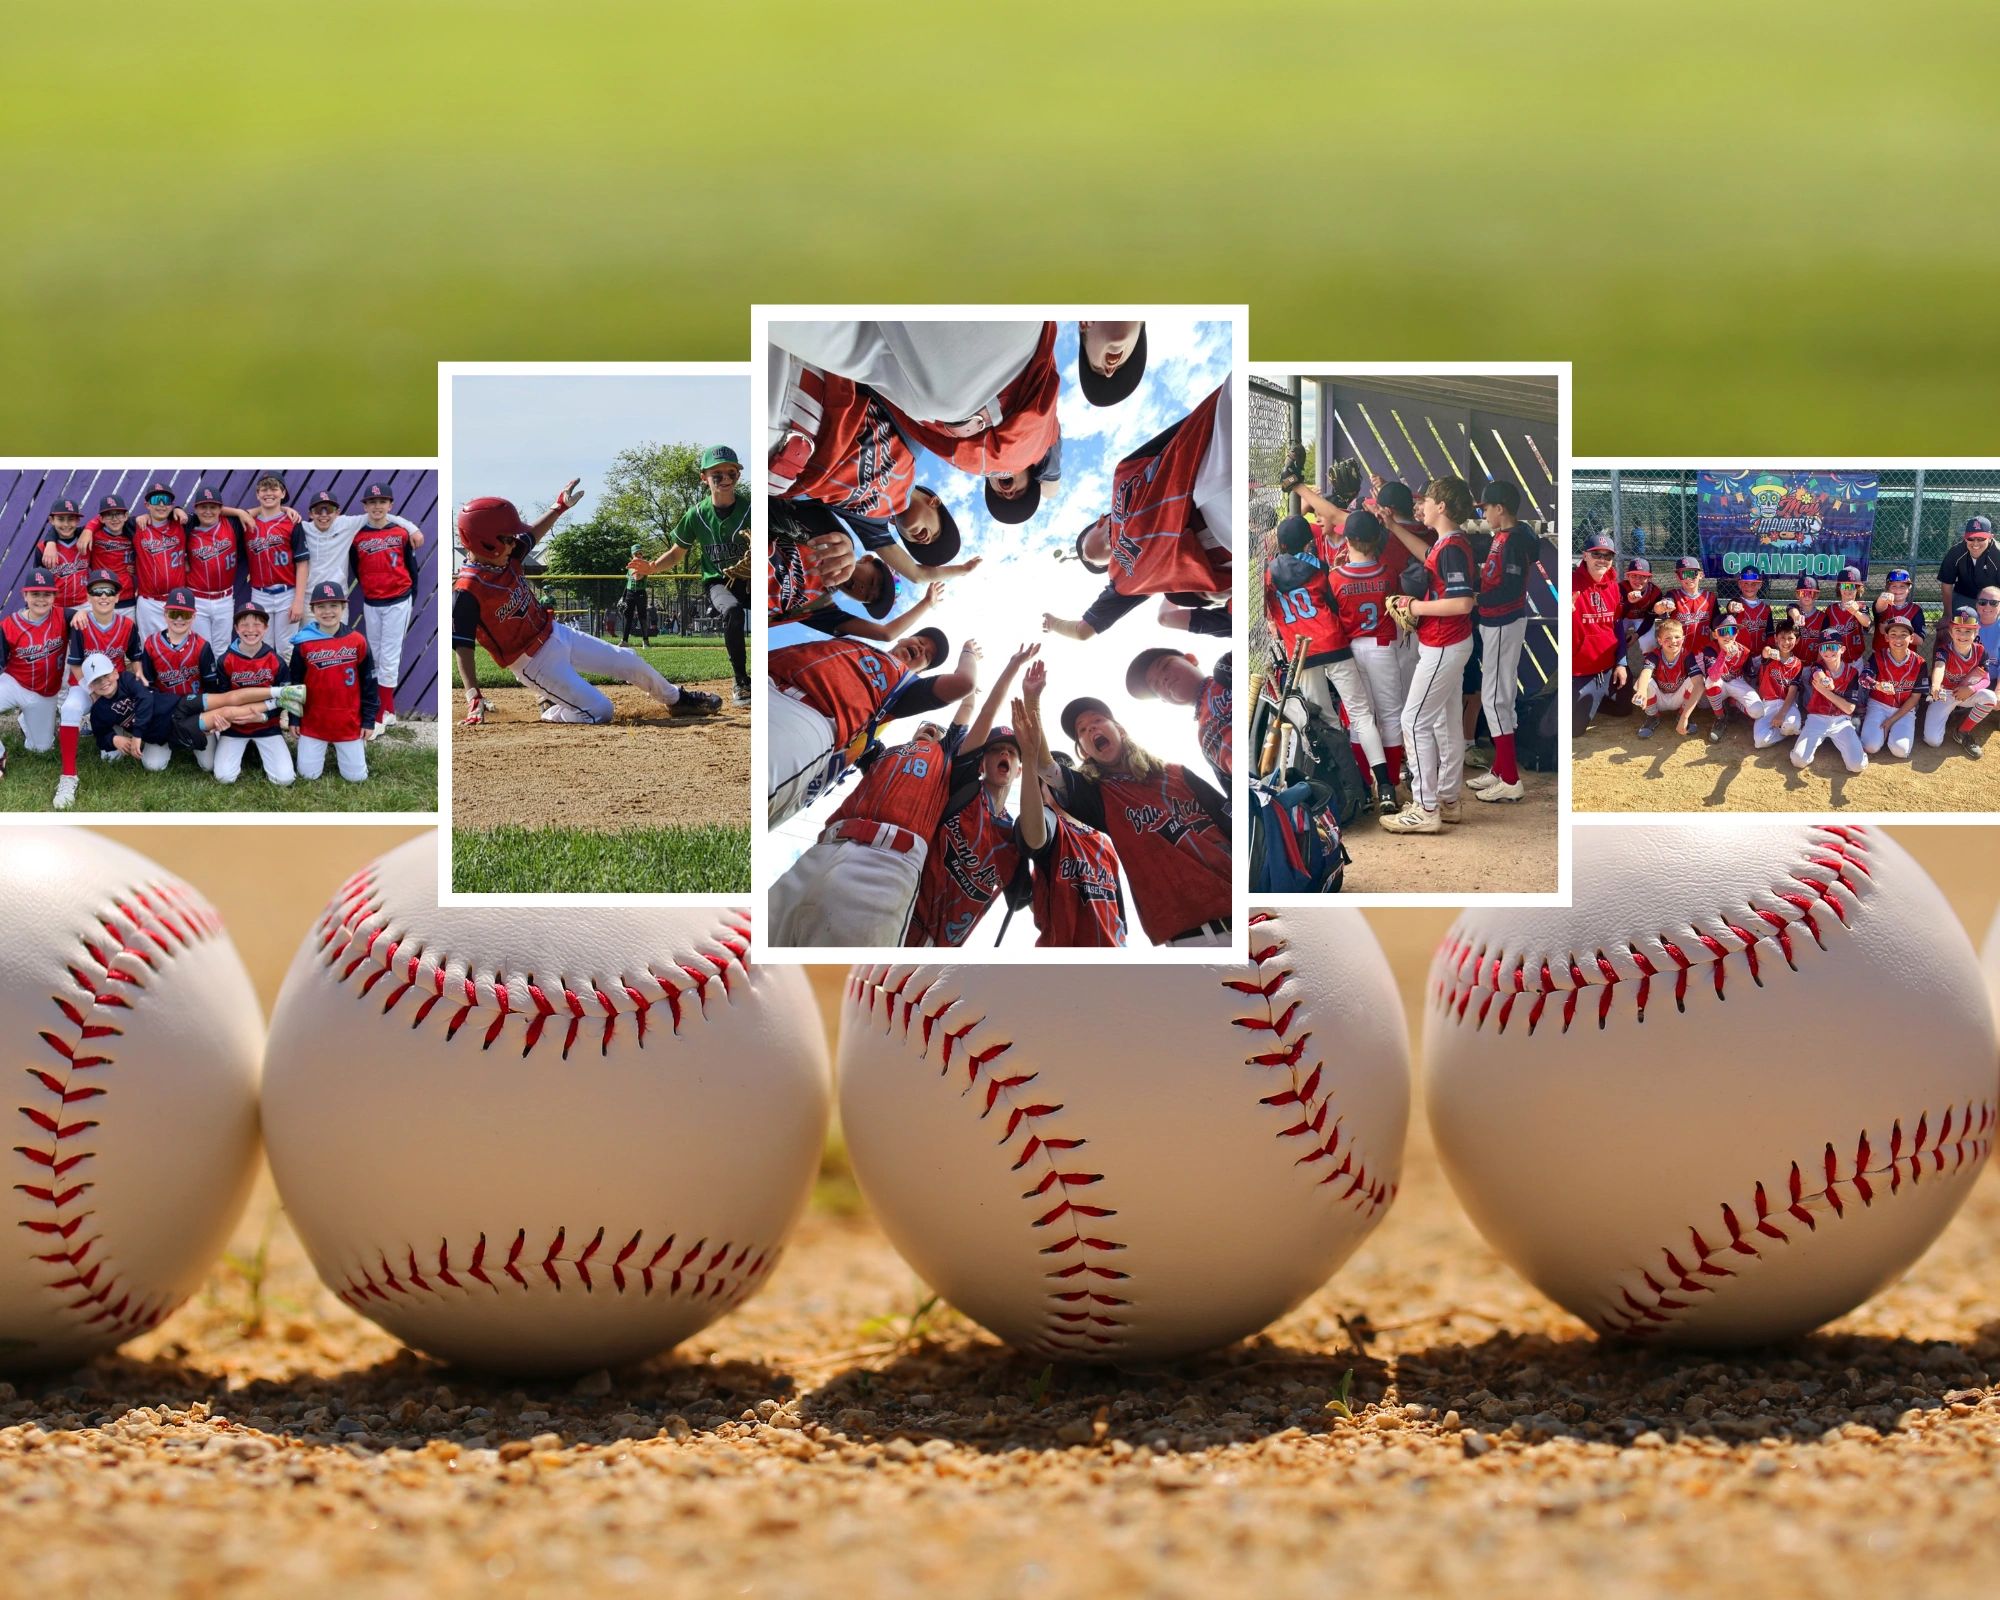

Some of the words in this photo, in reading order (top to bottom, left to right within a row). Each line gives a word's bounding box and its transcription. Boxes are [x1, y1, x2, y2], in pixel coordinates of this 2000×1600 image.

[1776, 498, 1820, 517] May
[1758, 518, 1812, 533] MADNESS
[1723, 552, 1846, 577] CHAMPION
[1276, 587, 1318, 624] 10
[1359, 602, 1378, 630] 3
[344, 667, 356, 686] 3
[902, 758, 928, 779] 18
